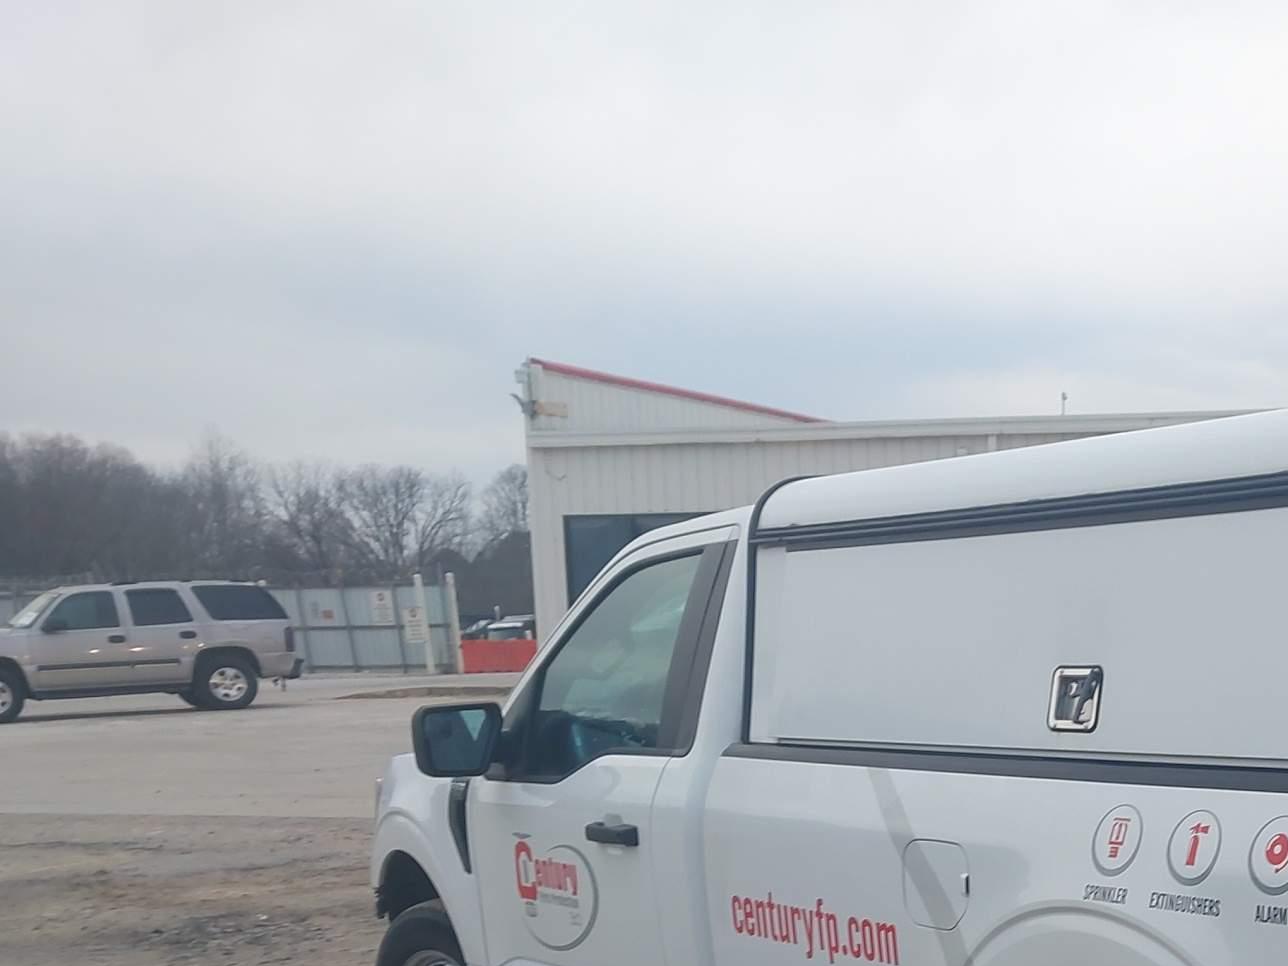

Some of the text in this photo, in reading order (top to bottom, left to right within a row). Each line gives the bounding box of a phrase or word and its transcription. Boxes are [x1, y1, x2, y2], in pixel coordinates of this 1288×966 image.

[515, 841, 578, 901] Century
[1083, 884, 1128, 904] SPRINKLER
[1149, 892, 1221, 917] EXTINGUISHERS
[1255, 905, 1288, 925] ALARM
[731, 892, 899, 966] centuryfp.com
